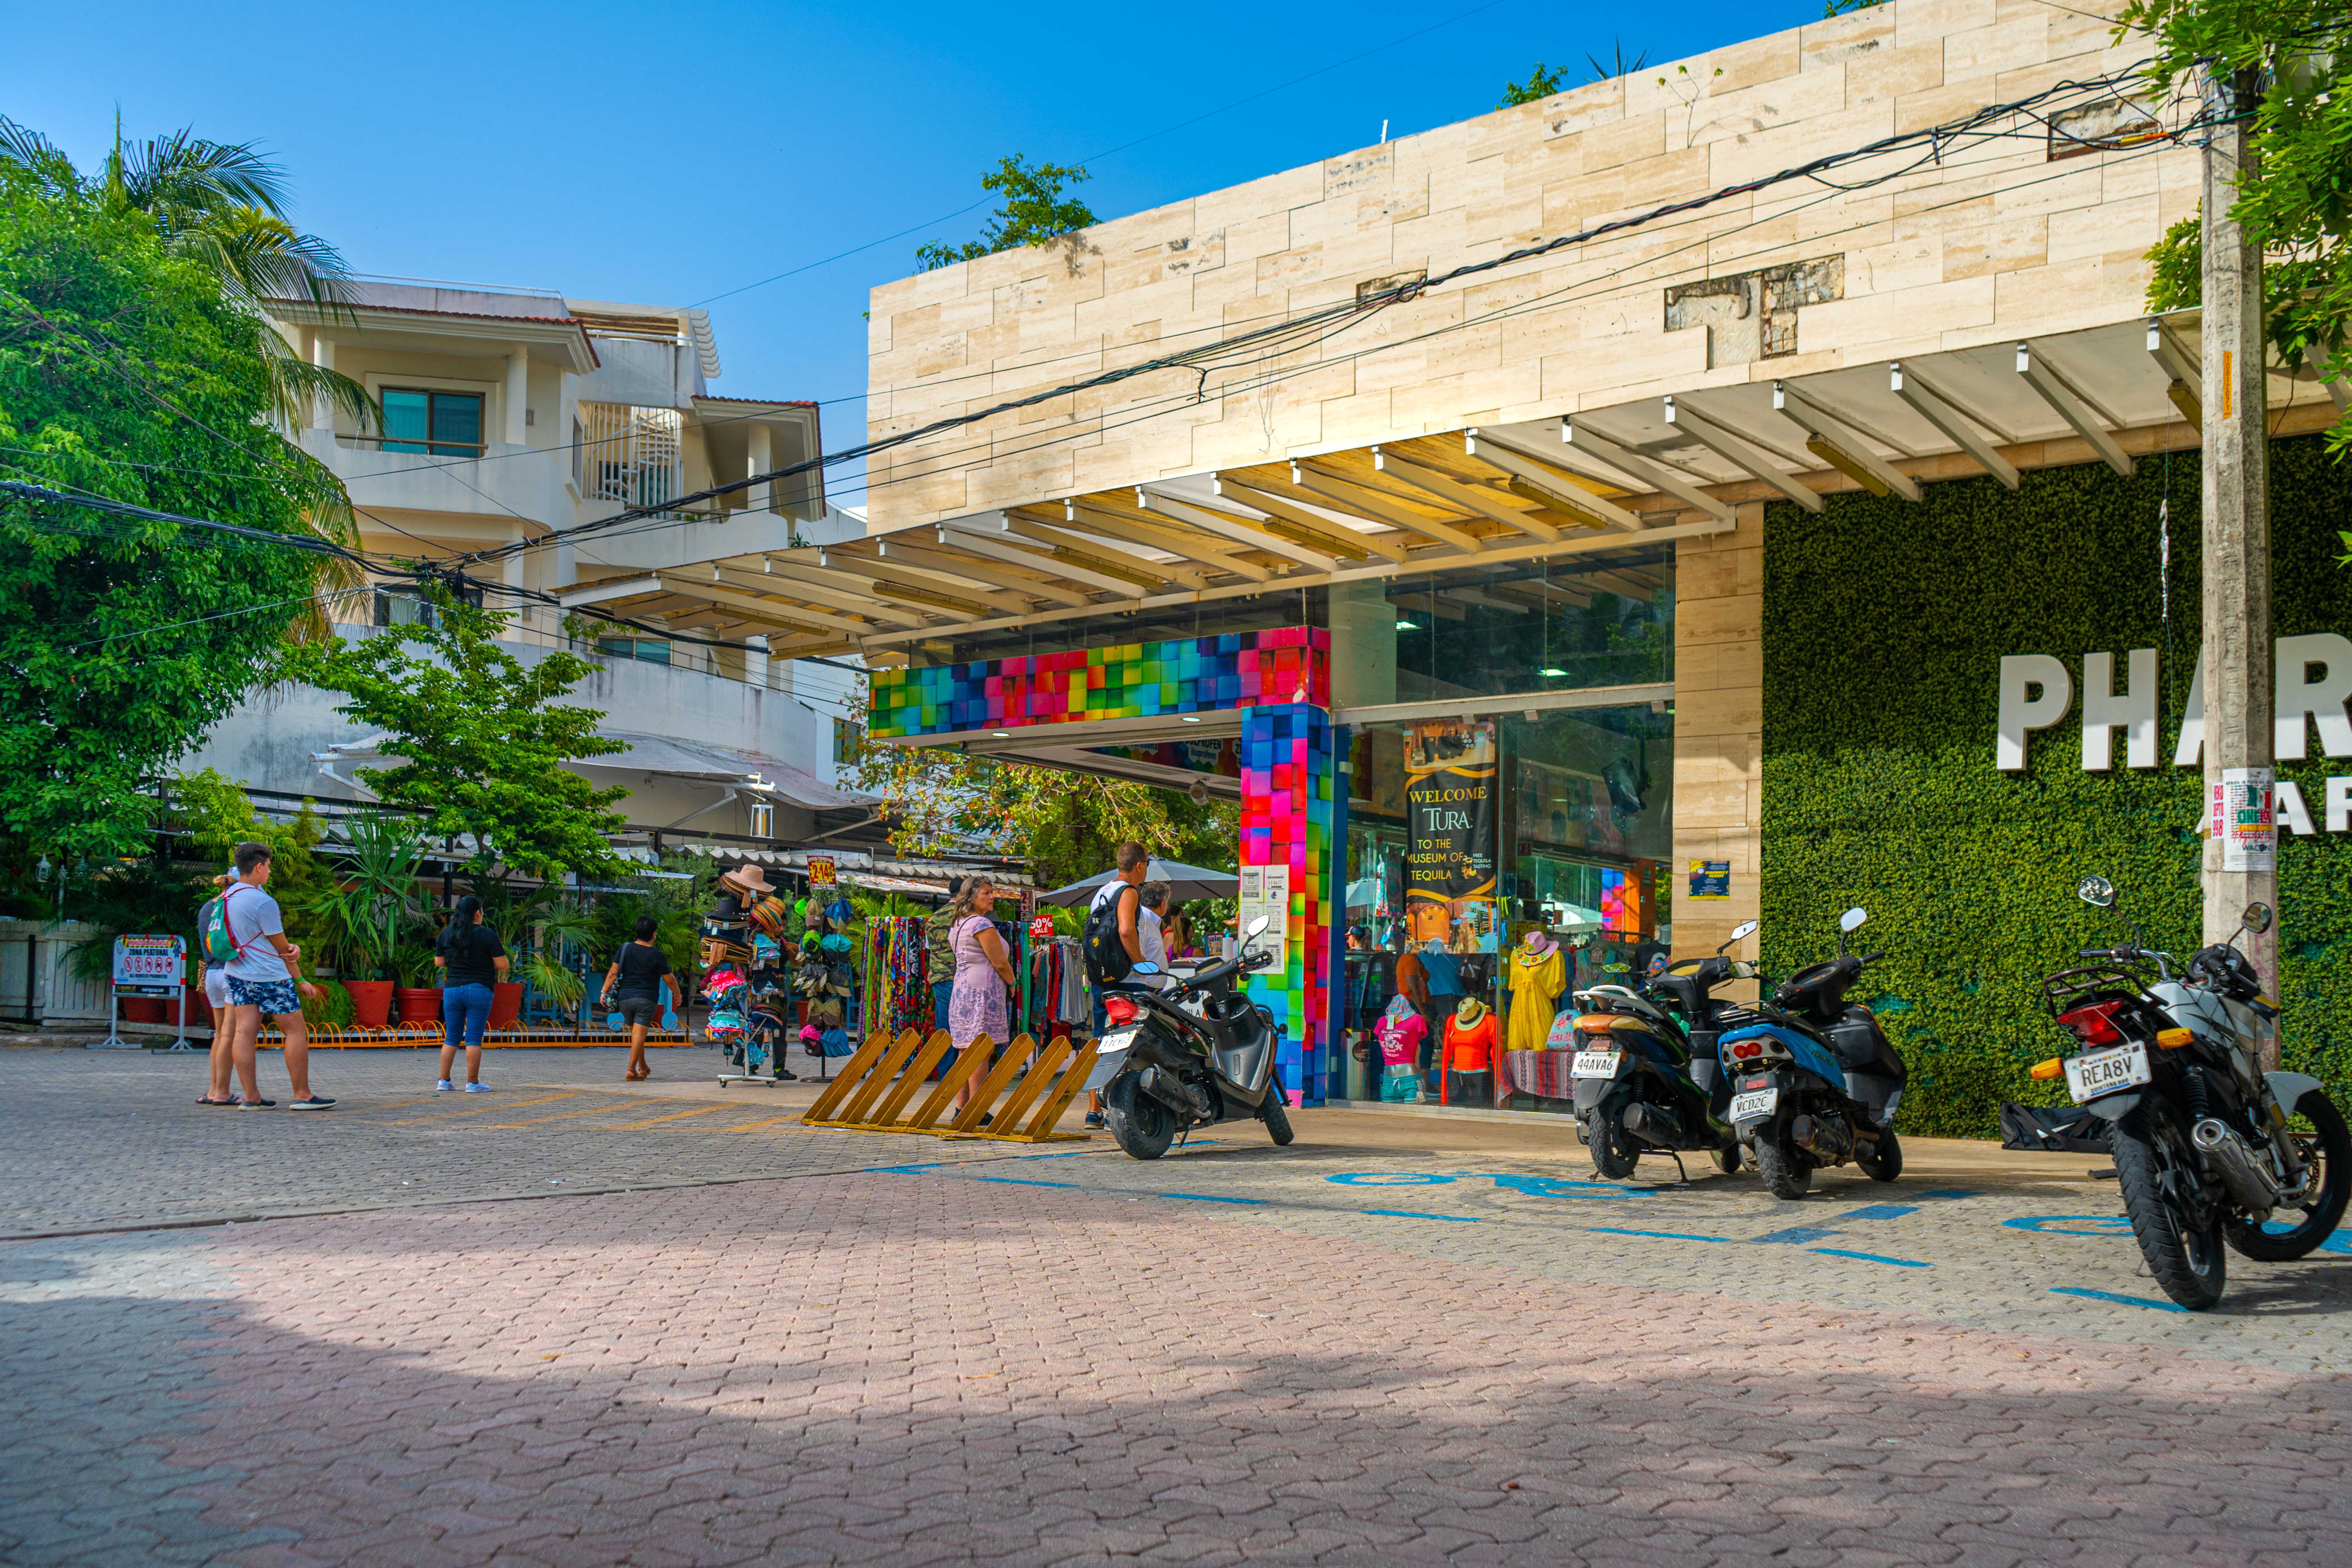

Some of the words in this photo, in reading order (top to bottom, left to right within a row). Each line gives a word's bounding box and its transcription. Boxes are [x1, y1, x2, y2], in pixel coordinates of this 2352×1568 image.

[1191, 747, 1216, 760] ibuprofeno
[1409, 786, 1487, 803] WELCOME
[1417, 839, 1432, 849] TO
[1436, 838, 1451, 848] THE
[1408, 853, 1446, 864] MUSEUM
[1450, 852, 1463, 862] OF
[1411, 870, 1452, 881] TEQUILA
[1103, 1036, 1130, 1047] 17CYG3
[1811, 1049, 1833, 1067] ITALIKA
[1577, 1059, 1613, 1070] 44AVA6
[2081, 1056, 2132, 1087] REA8V
[2090, 1082, 2117, 1094] QUINTANA
[1737, 1096, 1767, 1112] VCD2C
